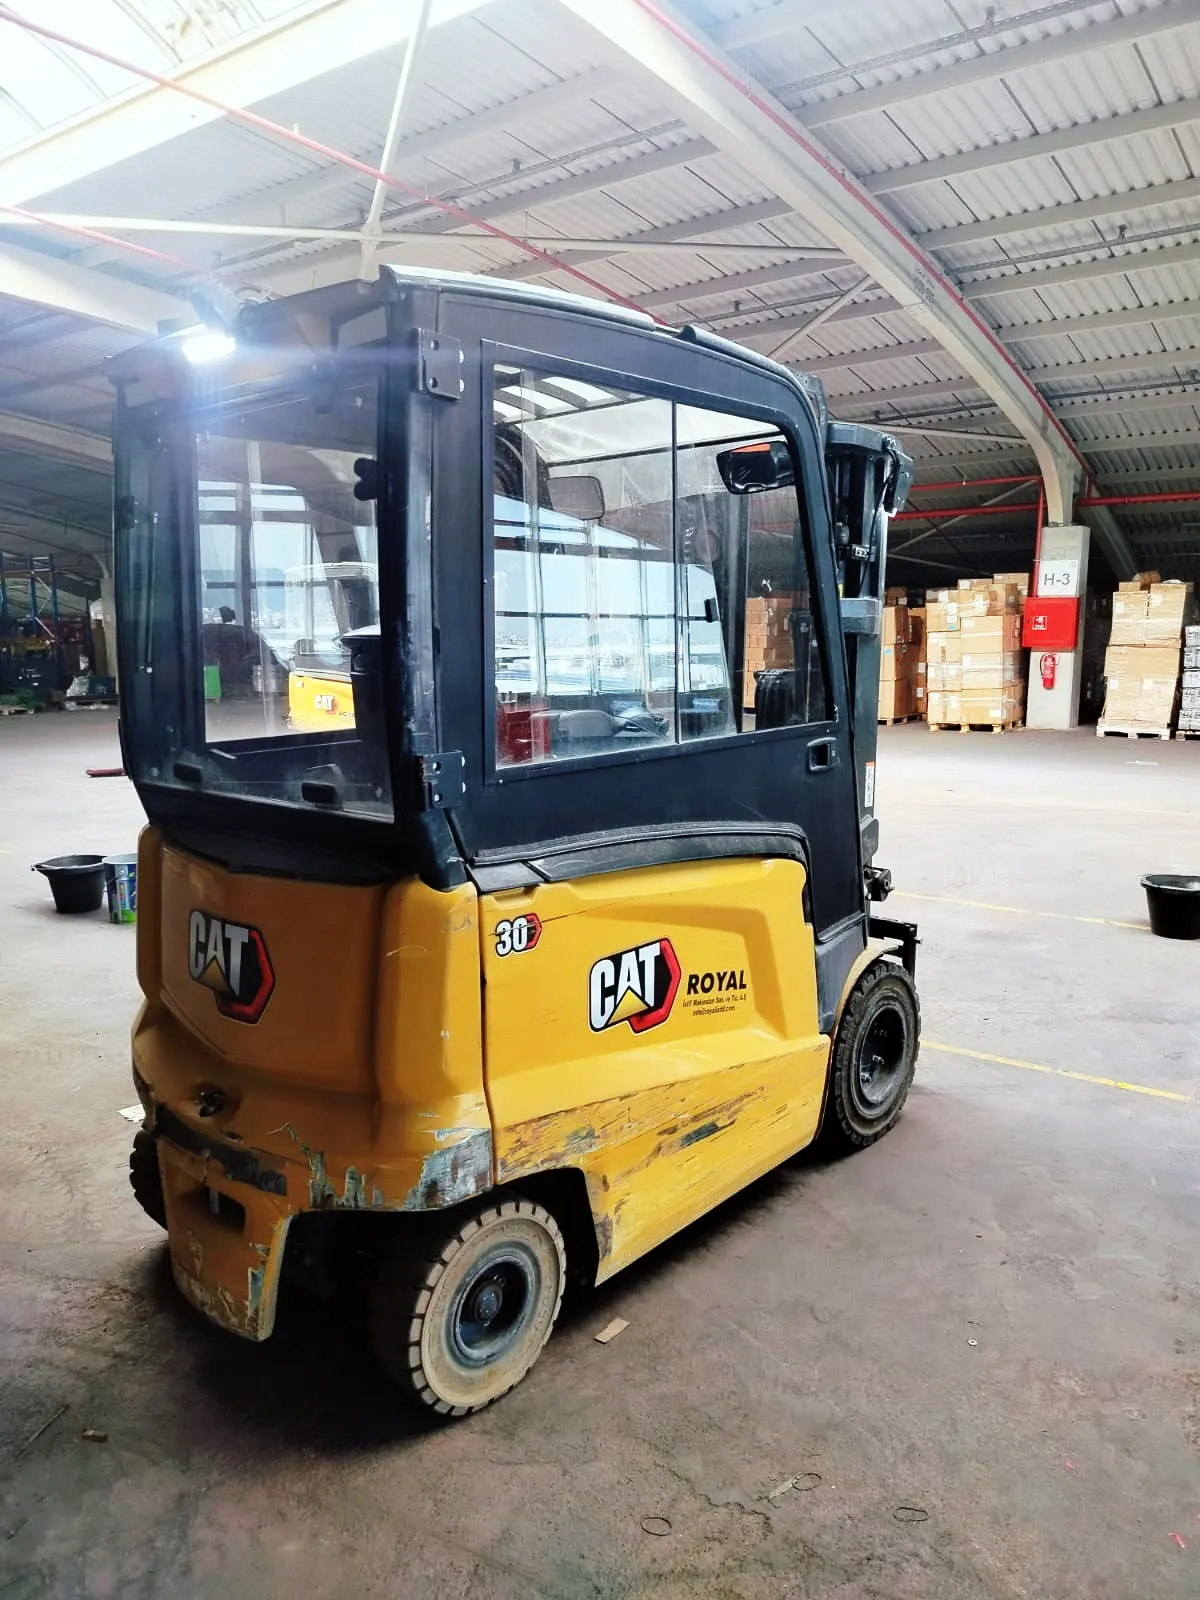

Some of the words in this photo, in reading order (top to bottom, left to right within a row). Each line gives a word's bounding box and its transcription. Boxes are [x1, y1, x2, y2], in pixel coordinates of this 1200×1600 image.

[1043, 572, 1071, 586] H-3
[189, 910, 249, 997] CAT
[495, 916, 529, 956] 30
[589, 941, 662, 1030] CAT
[686, 970, 747, 995] ROYAL
